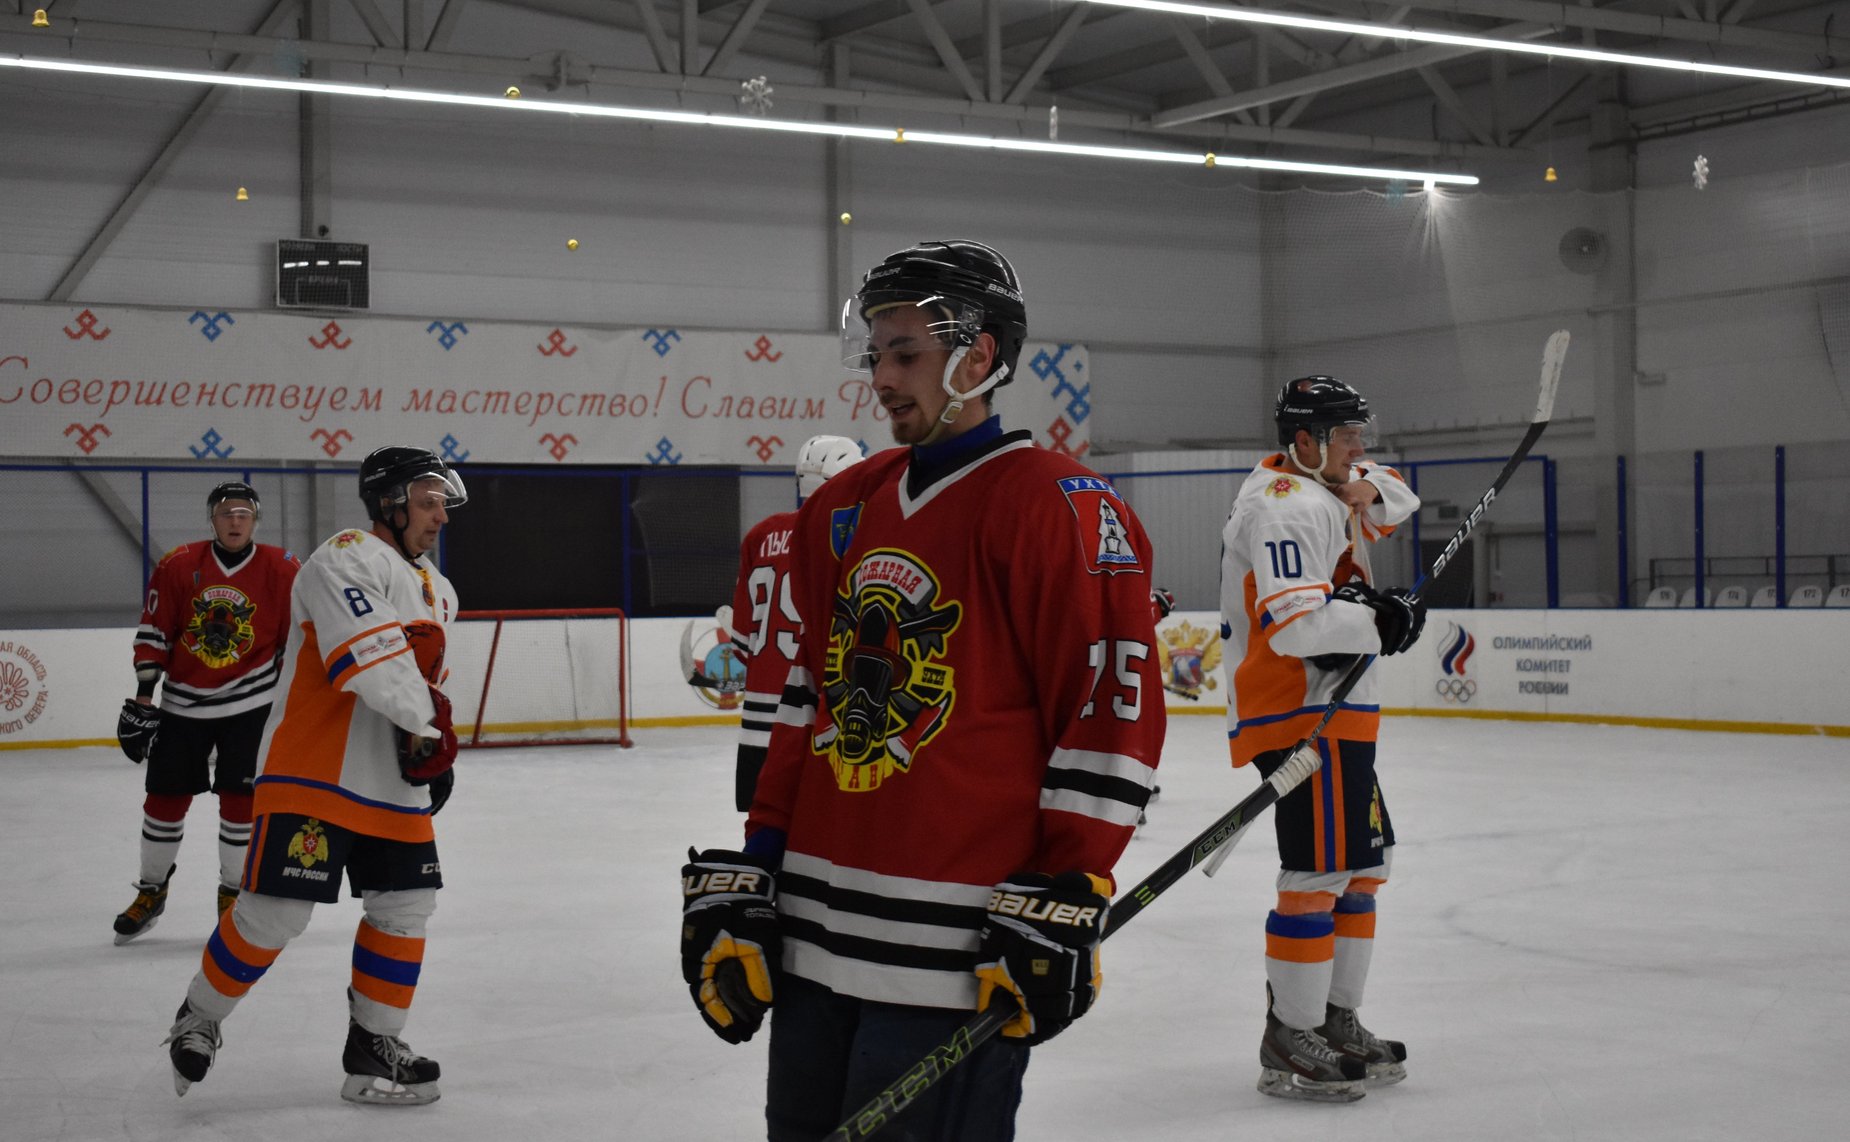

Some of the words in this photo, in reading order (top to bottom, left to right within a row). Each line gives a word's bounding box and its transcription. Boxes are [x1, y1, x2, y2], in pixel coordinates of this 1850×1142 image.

[0, 355, 383, 422] Совершенствуем
[402, 376, 668, 427] мастерство!
[681, 375, 826, 420] Славим
[1432, 487, 1496, 579] BAUER
[1264, 539, 1303, 578] 10
[343, 587, 374, 618] 8
[1493, 633, 1592, 651] ОЛИМПИЙСКИЙ
[16, 645, 48, 681] ОБЛАСТЬ
[1516, 658, 1571, 673] КОМИТЕТ
[1519, 681, 1568, 695] РОССИИ
[1201, 820, 1236, 854] CCM
[282, 866, 302, 878] МЧС
[300, 867, 330, 882] РОССИИ
[986, 889, 1099, 928] BAUER
